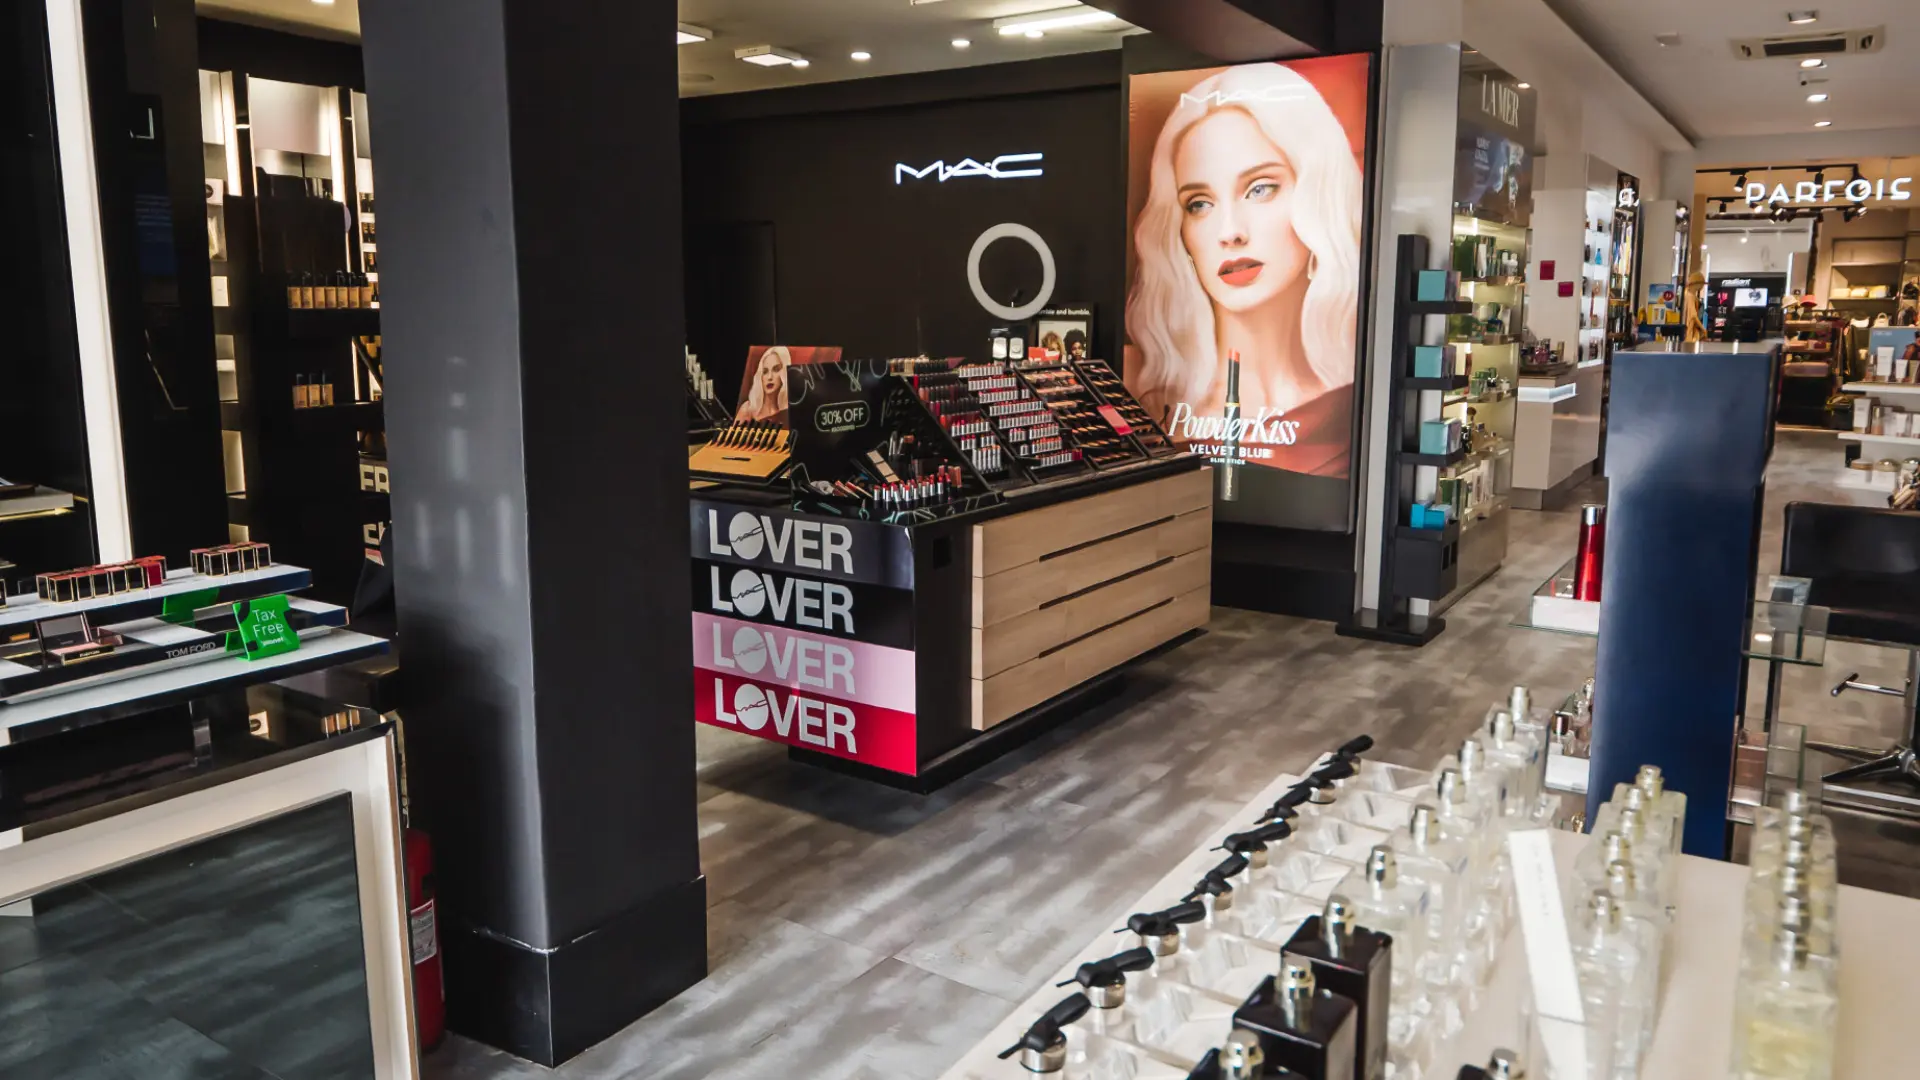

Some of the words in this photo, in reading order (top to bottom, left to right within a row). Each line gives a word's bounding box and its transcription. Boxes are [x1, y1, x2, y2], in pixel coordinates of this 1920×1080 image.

[820, 409, 843, 427] 30%
[843, 407, 864, 423] OFF
[1189, 443, 1236, 457] VELVET
[709, 508, 854, 575] LOVER
[710, 565, 856, 634] LOVER
[251, 608, 277, 623] Tax
[252, 623, 285, 638] Free
[164, 646, 189, 659] TOM
[189, 641, 217, 655] FORD
[713, 622, 856, 695] LOVER
[714, 677, 858, 755] LOVER
